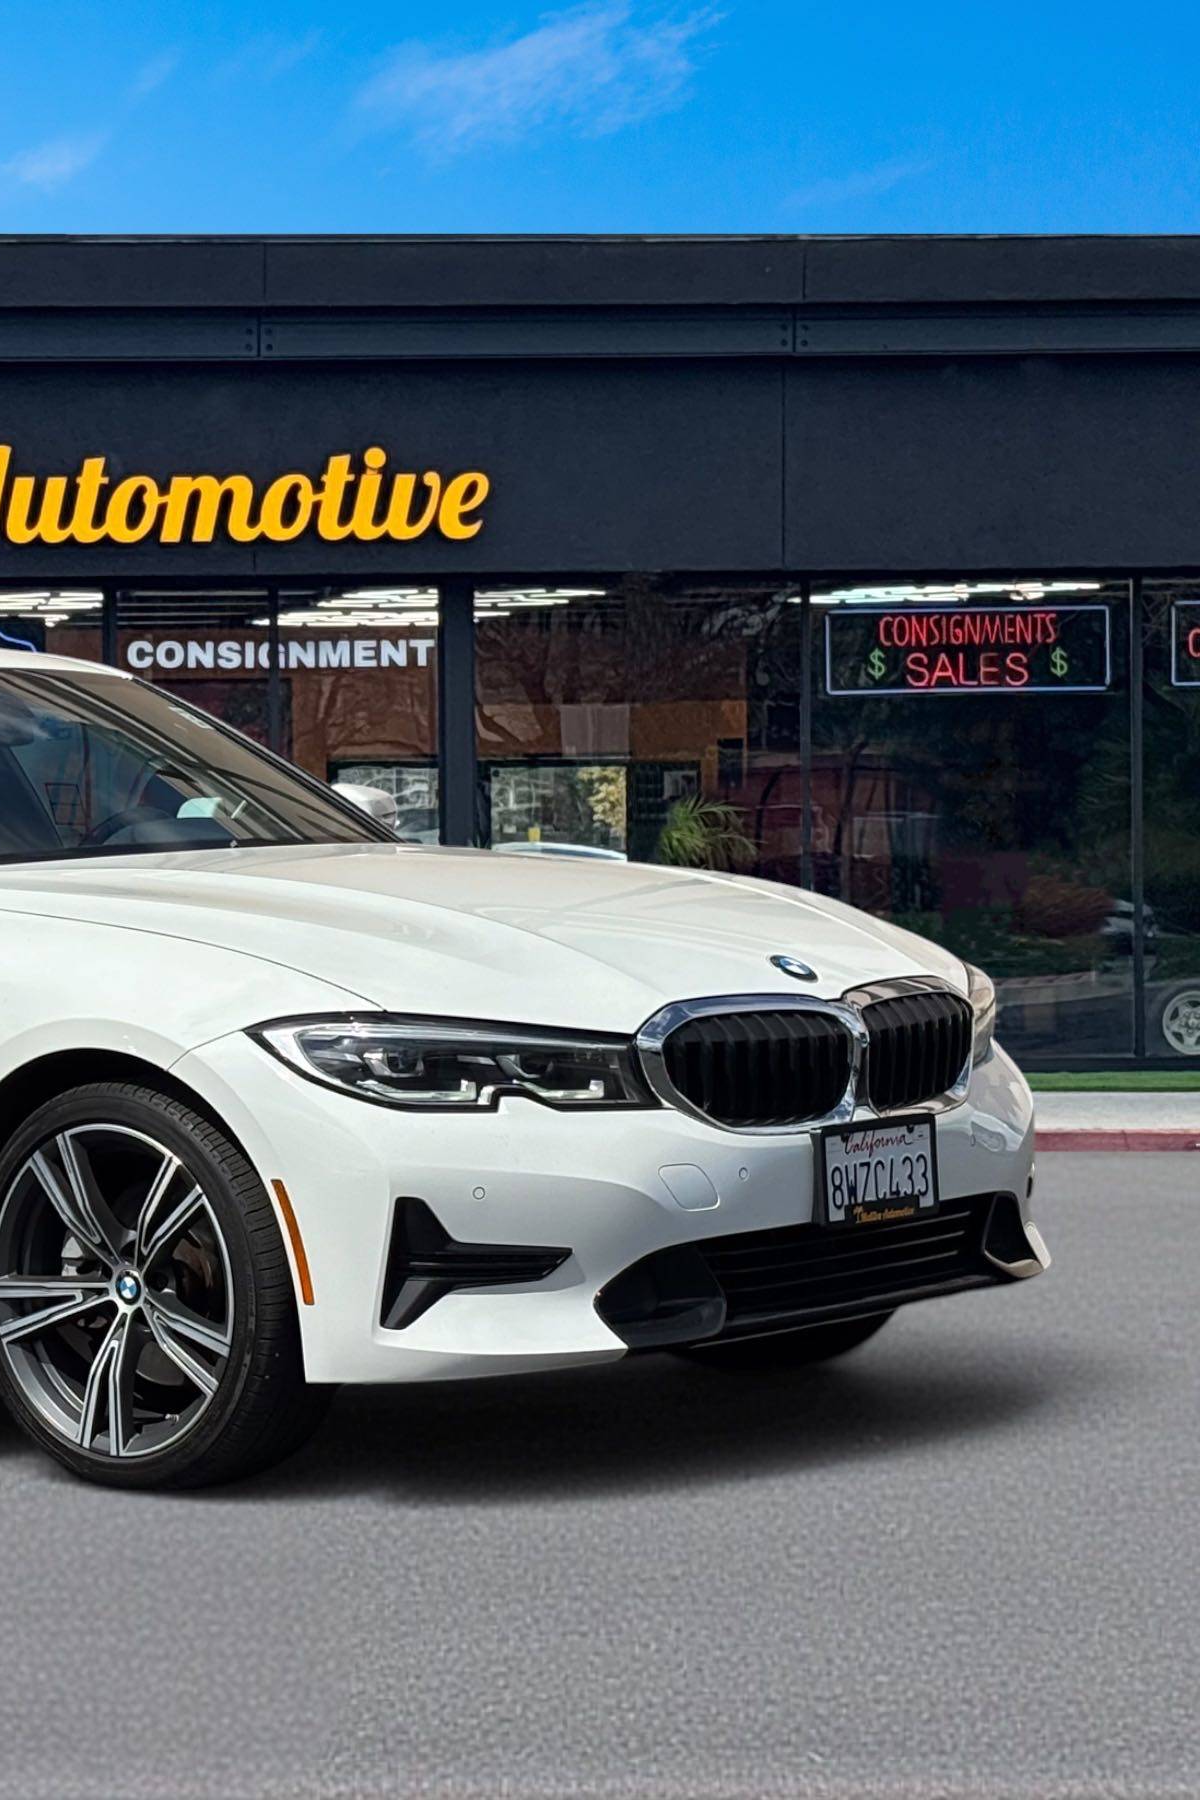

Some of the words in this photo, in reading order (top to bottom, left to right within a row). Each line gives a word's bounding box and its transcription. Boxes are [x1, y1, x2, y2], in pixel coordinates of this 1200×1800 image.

[879, 614, 1057, 647] CONSIGNMENTS
[126, 639, 435, 669] CONSIGNMENT
[906, 652, 1029, 687] SALES
[844, 1130, 912, 1157] California
